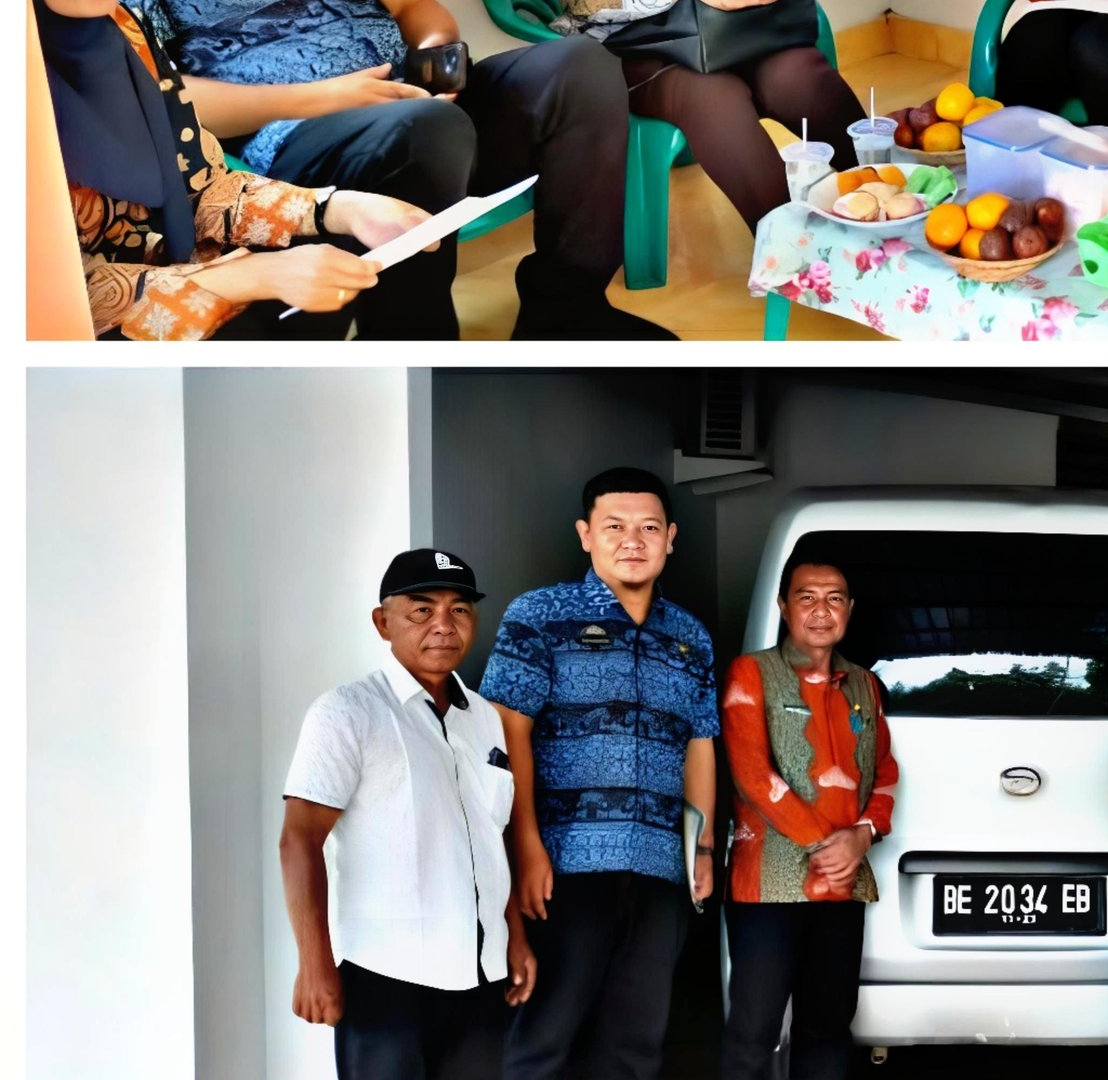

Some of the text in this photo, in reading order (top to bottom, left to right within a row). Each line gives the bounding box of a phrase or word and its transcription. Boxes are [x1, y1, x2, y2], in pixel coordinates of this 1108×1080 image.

[943, 883, 1091, 915] BE 2034 EB
